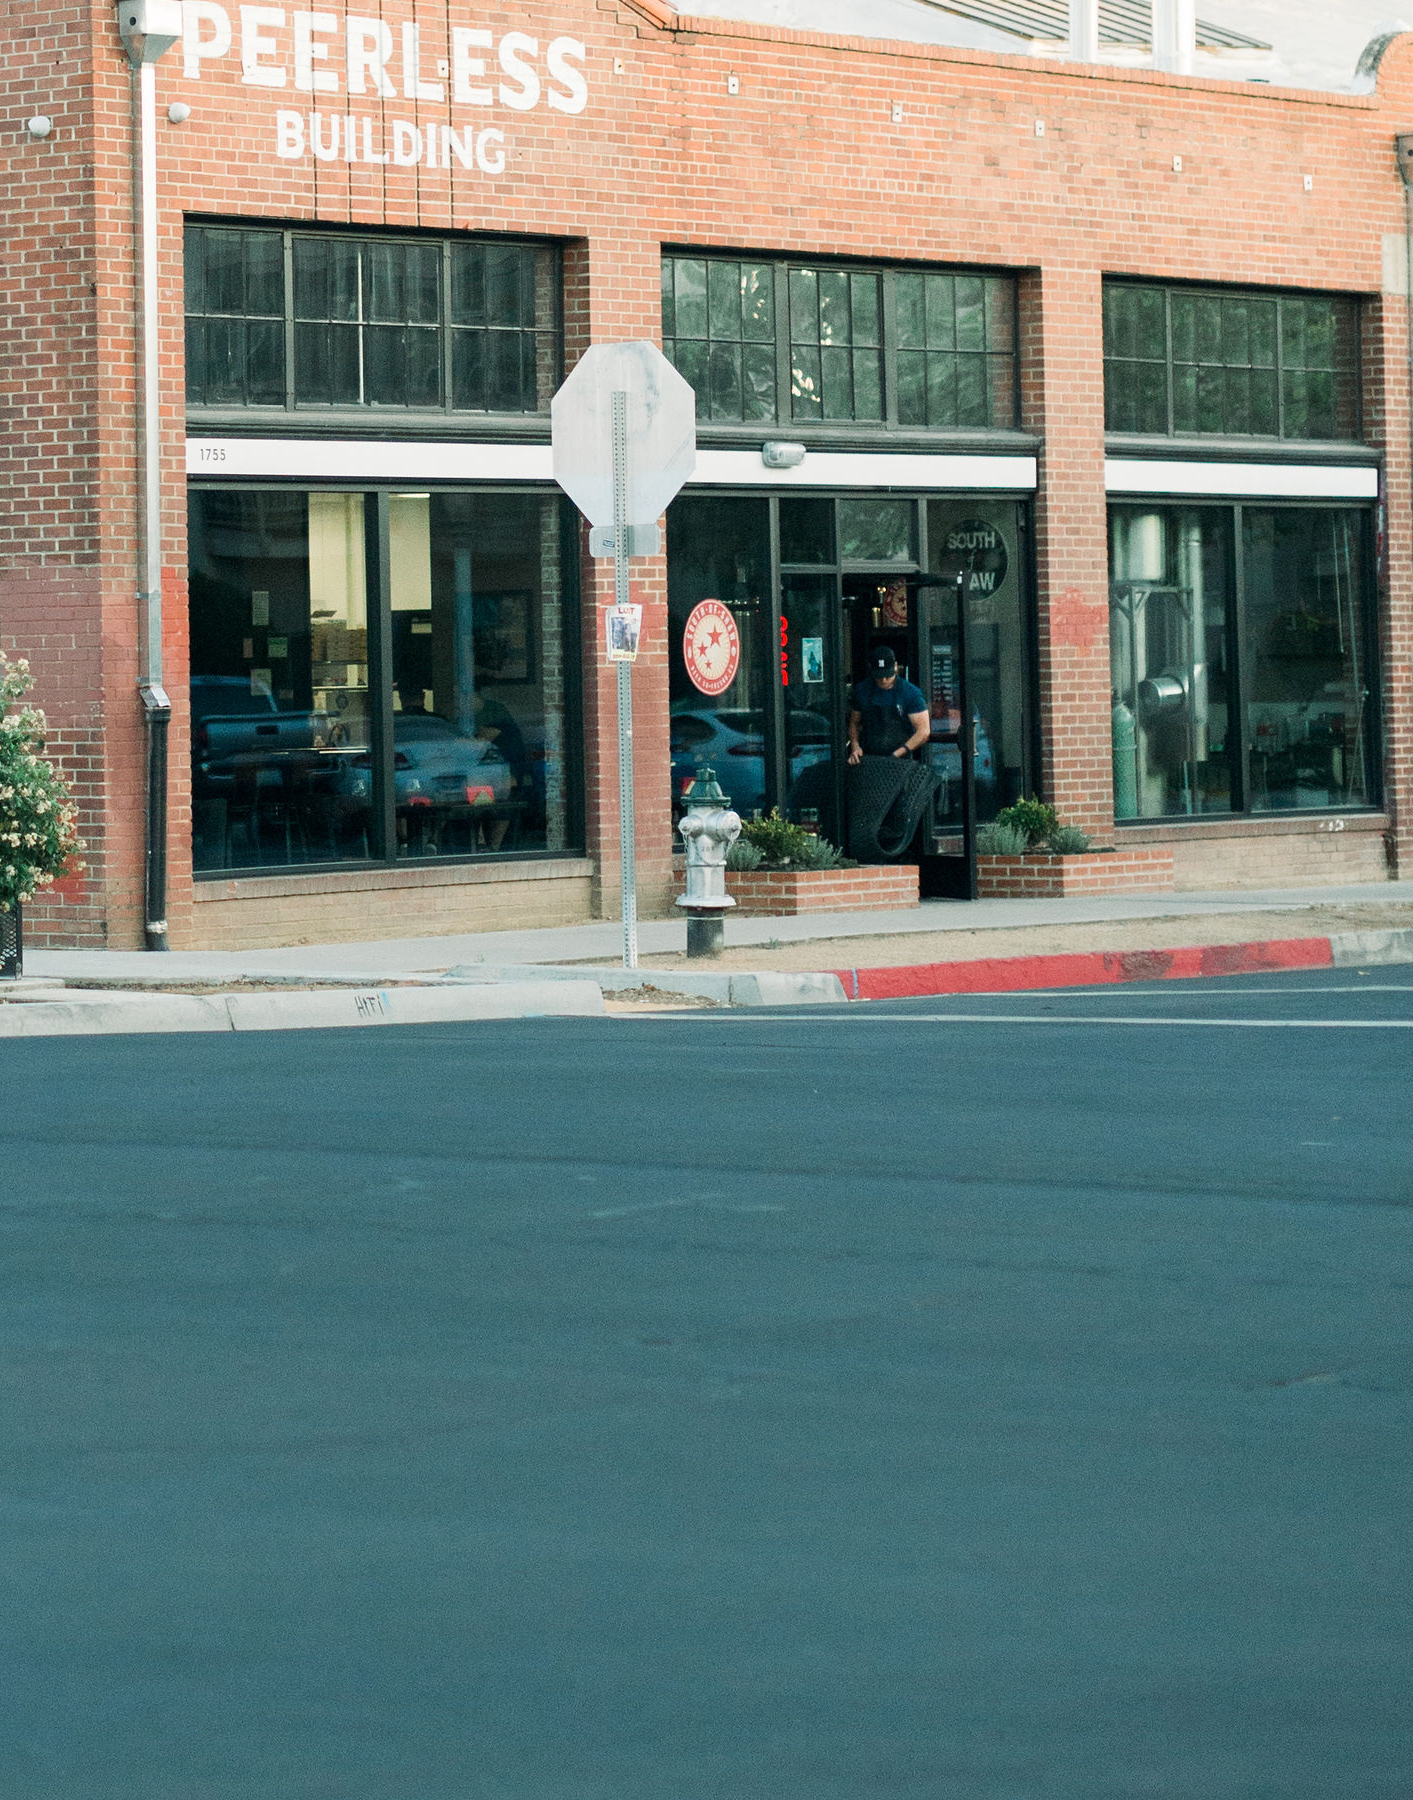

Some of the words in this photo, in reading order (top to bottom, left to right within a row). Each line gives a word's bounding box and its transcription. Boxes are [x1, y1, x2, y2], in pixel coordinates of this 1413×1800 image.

[182, 0, 589, 114] PEERLESS
[276, 110, 507, 175] BUILDING
[200, 448, 226, 461] 1755
[948, 531, 996, 549] SOUTH
[686, 606, 705, 640] SOUTH
